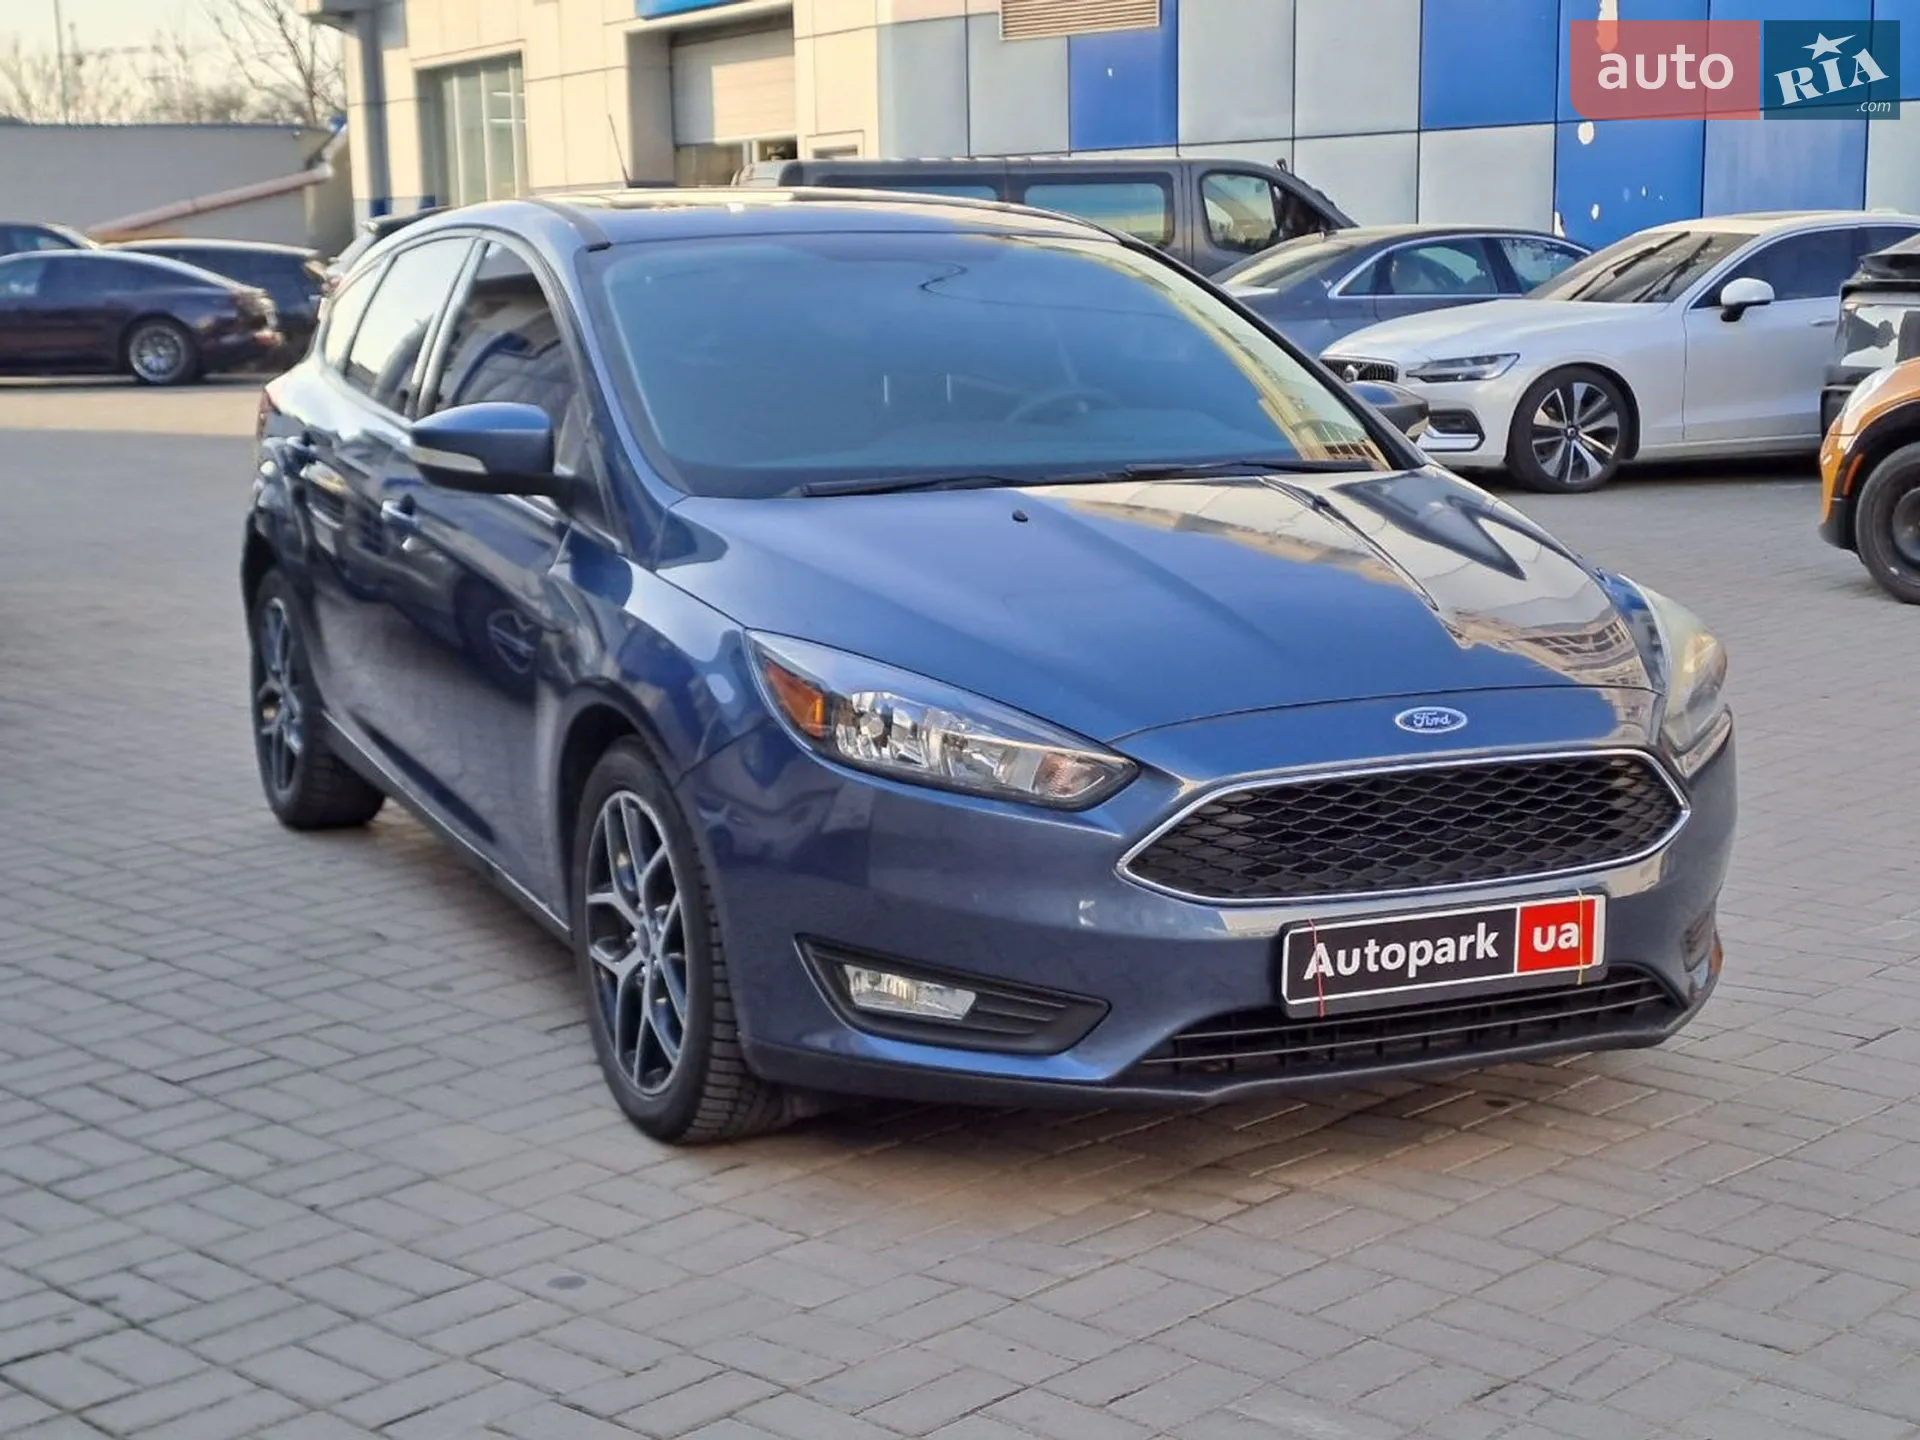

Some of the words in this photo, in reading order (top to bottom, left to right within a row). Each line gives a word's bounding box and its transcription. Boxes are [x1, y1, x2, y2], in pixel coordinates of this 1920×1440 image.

[1413, 712, 1452, 727] Ford
[1303, 922, 1499, 980] Autopark
[1533, 921, 1580, 953] ua
